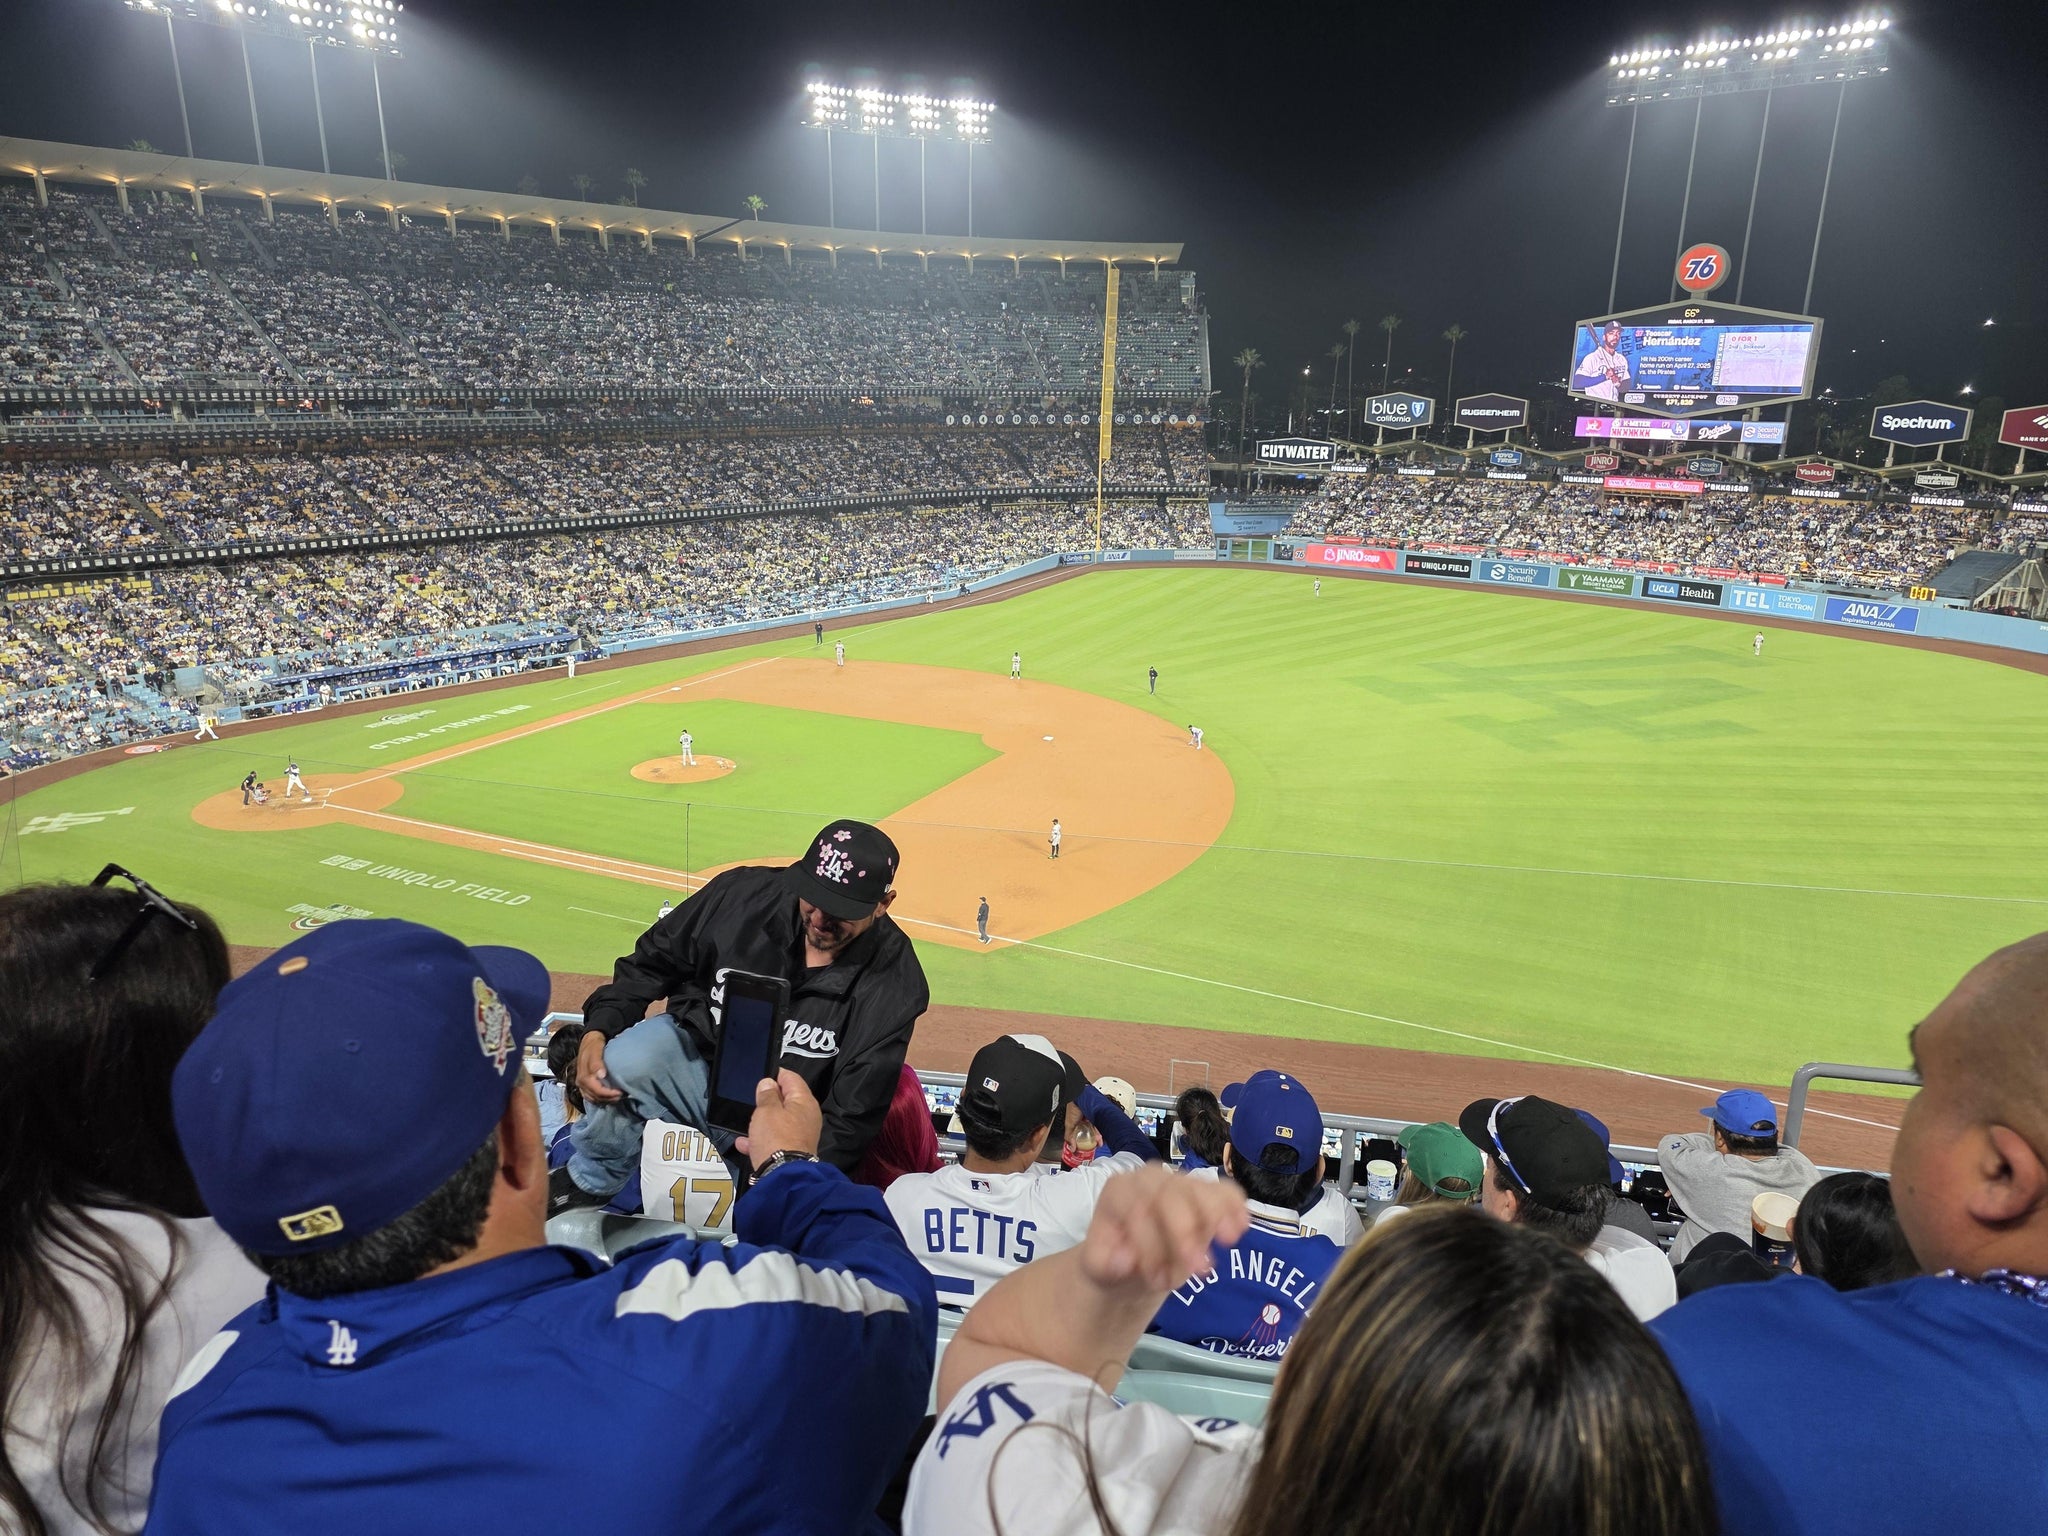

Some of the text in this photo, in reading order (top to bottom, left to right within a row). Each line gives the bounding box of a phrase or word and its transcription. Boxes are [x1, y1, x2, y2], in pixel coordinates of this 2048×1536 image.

[1684, 254, 1718, 281] 76
[1642, 336, 1702, 346] Hernández
[1371, 400, 1407, 415] blue
[1461, 409, 1520, 417] GUGGENHEIM
[1376, 415, 1411, 423] california
[1881, 415, 1951, 430] Spectrum
[1698, 422, 1733, 440] Dodgers
[1757, 426, 1782, 435] Security
[1757, 432, 1777, 440] Benefit
[1261, 444, 1330, 460] CUTWATER
[1590, 455, 1613, 466] JINRO
[1799, 467, 1832, 477] Yakult
[1336, 548, 1364, 562] JINRO
[1421, 561, 1447, 571] UNIQLO
[1448, 564, 1470, 573] FIELD
[1507, 564, 1538, 577] Security
[1507, 573, 1534, 584] Benefit
[1652, 584, 1715, 600] UCLA Health
[1733, 589, 1770, 610] TEL
[1778, 594, 1801, 604] TOKYO
[1910, 586, 1936, 601] 0:07
[1778, 601, 1813, 612] ELECTRON
[1843, 602, 1880, 619] ANA
[1841, 616, 1869, 626] Inspiration
[1877, 621, 1896, 629] JAPAN
[816, 849, 844, 883] LA
[366, 864, 532, 906] UNIQLO FIELD
[669, 1177, 735, 1228] 17
[924, 1207, 1038, 1264] BETTS
[1230, 1249, 1316, 1318] ANGEL
[326, 1319, 359, 1365] LA
